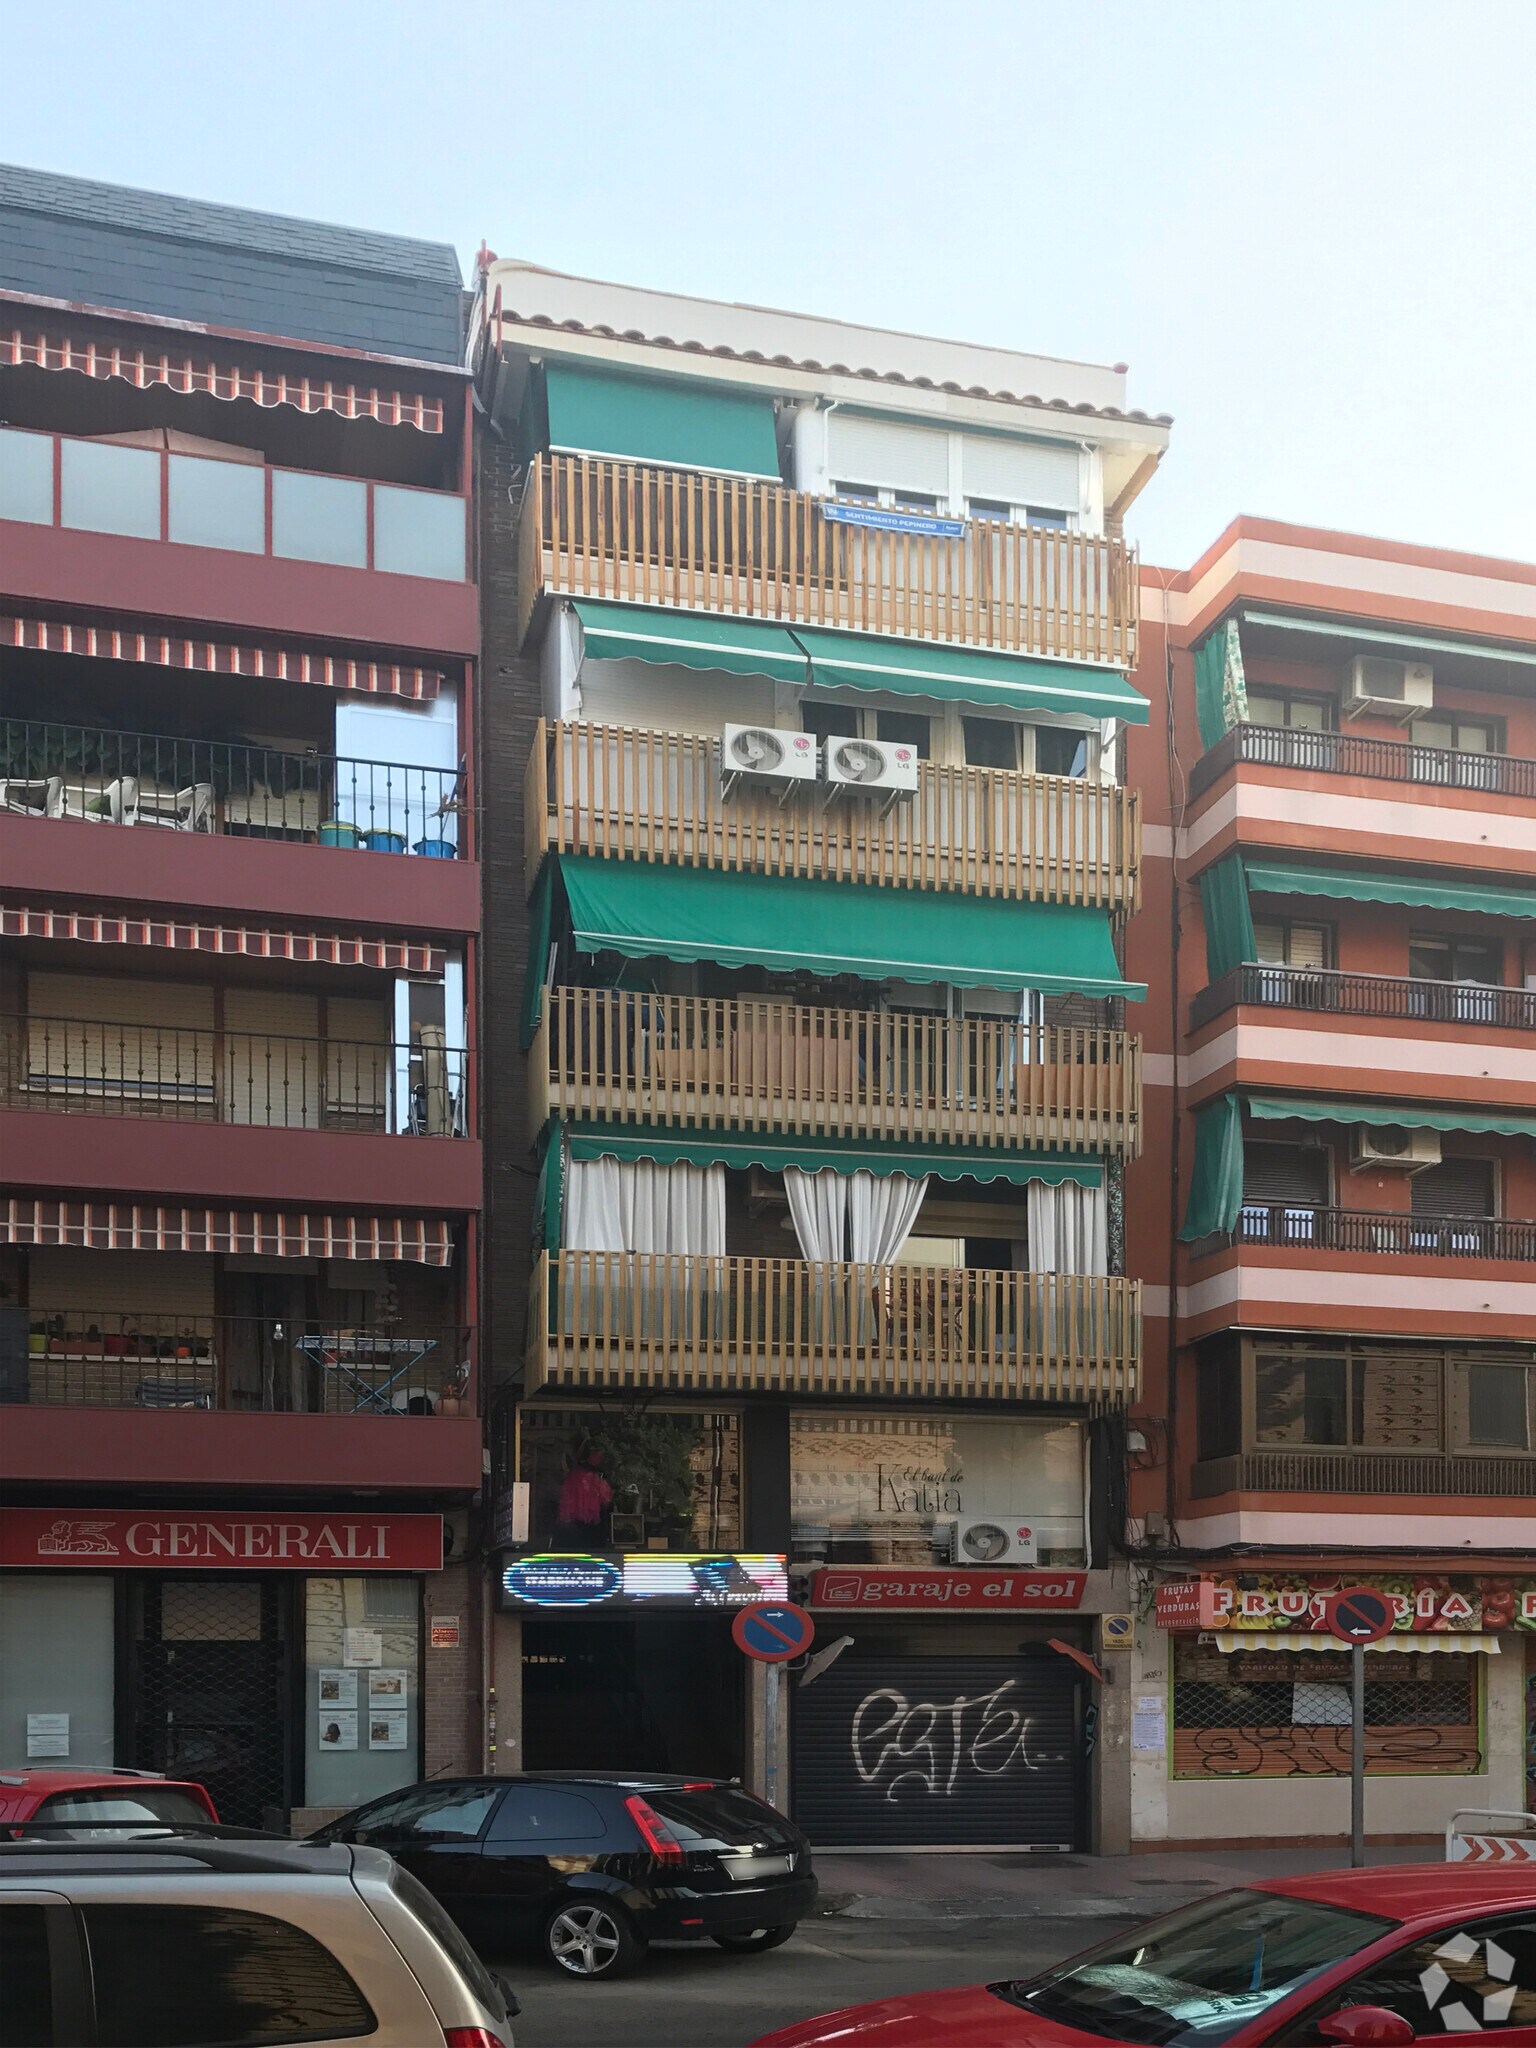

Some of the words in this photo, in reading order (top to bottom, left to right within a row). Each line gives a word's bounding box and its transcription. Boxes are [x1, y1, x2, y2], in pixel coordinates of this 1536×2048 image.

[845, 511, 898, 525] SENTIMIENTO
[899, 518, 937, 530] PEPINERO
[795, 750, 809, 759] LG
[896, 761, 910, 770] LG
[902, 1465, 917, 1481] El
[950, 1468, 964, 1483] de
[873, 1462, 965, 1513] Katia
[125, 1521, 391, 1559] GENERALI
[862, 1577, 971, 1603] garaje
[982, 1579, 1013, 1597] el
[1023, 1579, 1076, 1599] sol
[1163, 1584, 1194, 1596] FRUTAS
[1175, 1595, 1181, 1603] Y
[1157, 1601, 1200, 1614] VERDURAS
